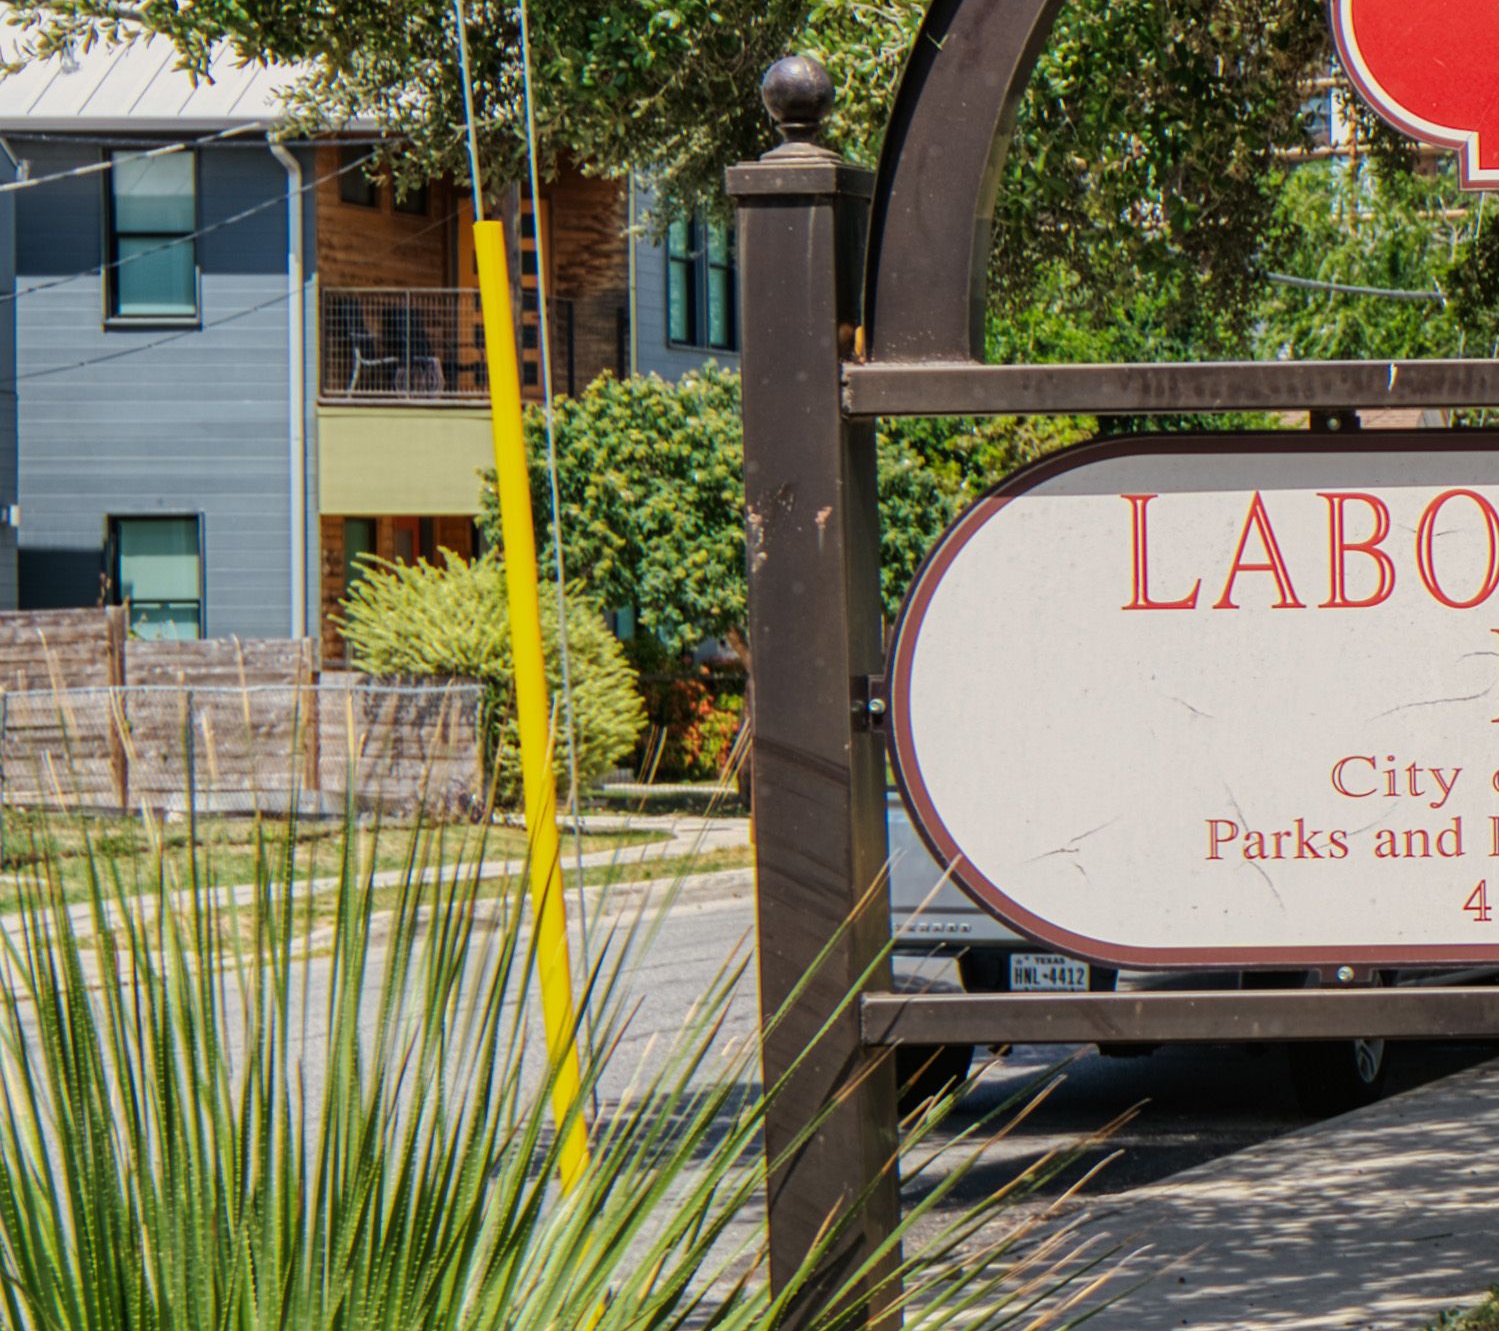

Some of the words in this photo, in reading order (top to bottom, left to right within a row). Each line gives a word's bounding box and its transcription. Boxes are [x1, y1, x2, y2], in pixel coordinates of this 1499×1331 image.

[1330, 754, 1462, 810] City
[1206, 816, 1350, 862] Parks
[1373, 815, 1466, 859] and
[1034, 956, 1066, 964] TEXAS
